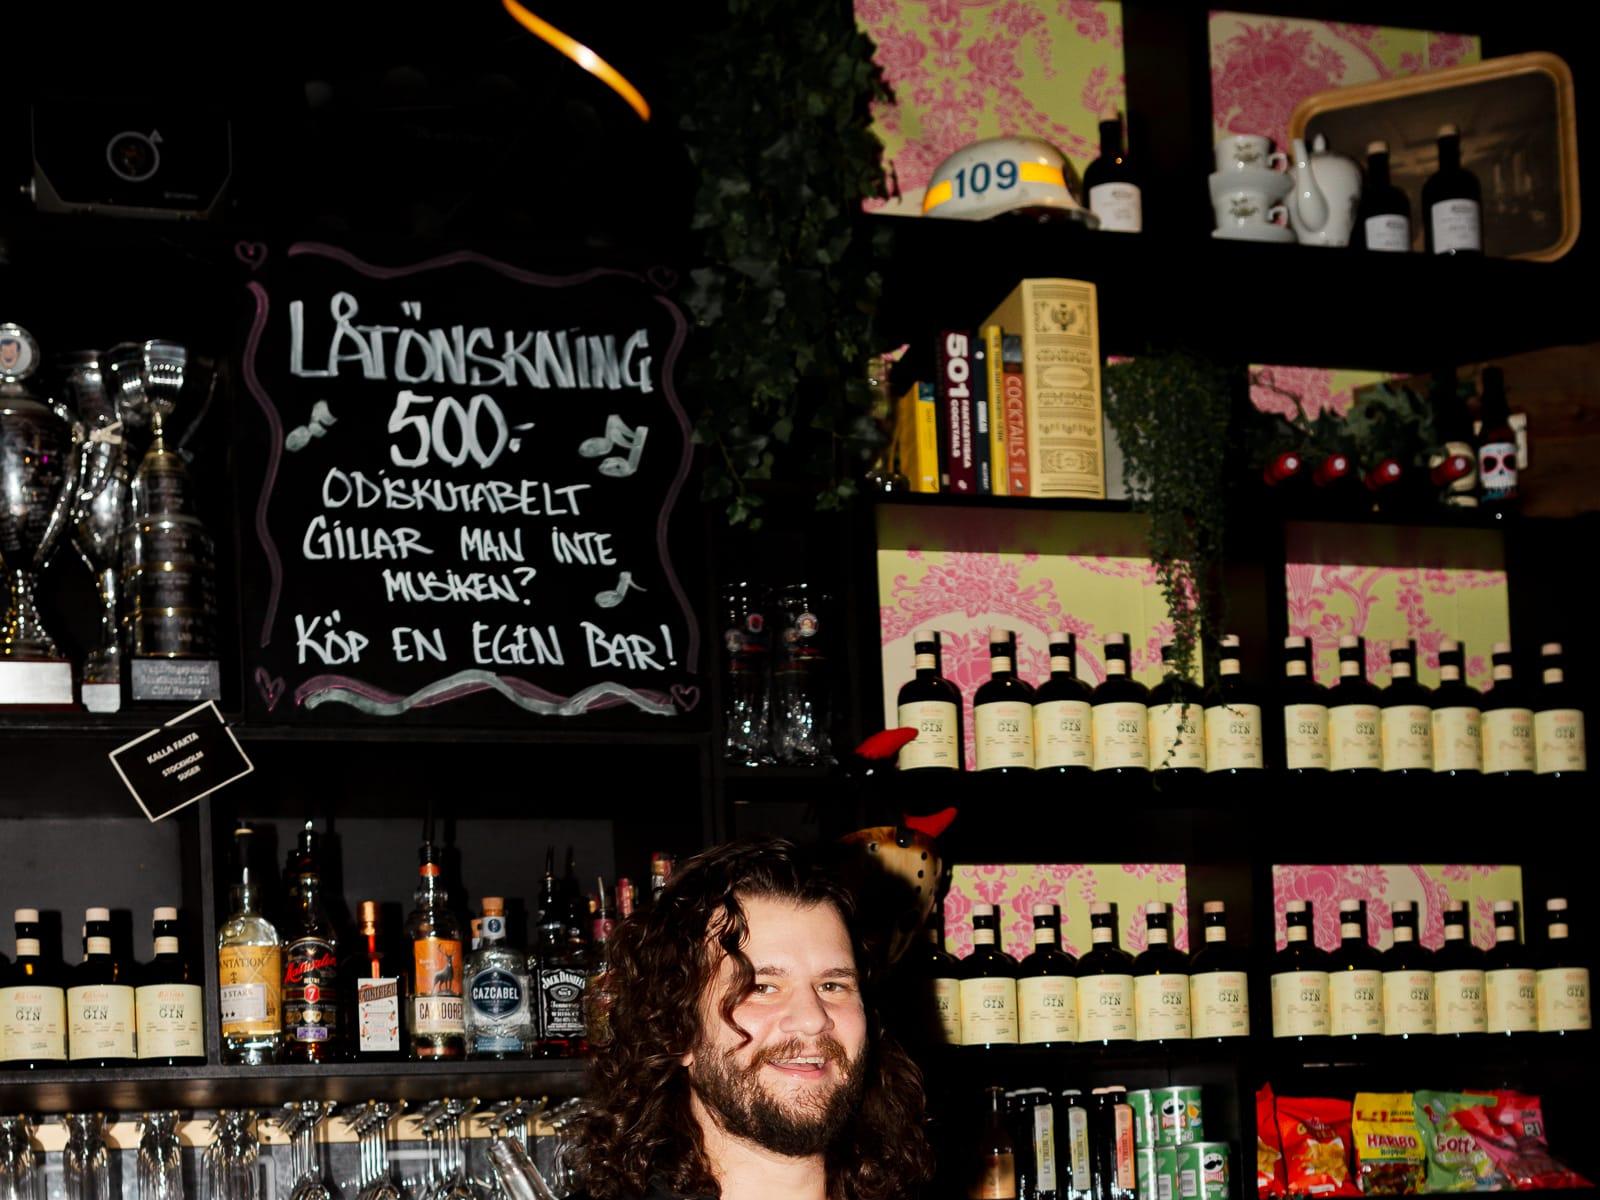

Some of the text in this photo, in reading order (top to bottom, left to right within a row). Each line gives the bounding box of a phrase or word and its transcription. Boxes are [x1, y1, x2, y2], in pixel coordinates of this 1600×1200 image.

[955, 160, 1019, 199] 109
[289, 291, 653, 393] LÅTÖNSKNING
[946, 333, 970, 398] 501
[1005, 375, 1026, 458] COCKTAILS
[950, 400, 961, 458] COCKTAILS
[961, 400, 972, 469] FANTASTISKA
[322, 467, 591, 515] ODISKUTABELT
[303, 515, 617, 565] GILLAR MAN INTE
[382, 567, 537, 605] MUSIKEN?
[295, 609, 678, 671] KÖP EN EGEN BAR!
[920, 722, 943, 733] GIN
[1060, 720, 1081, 732] GIN
[1117, 721, 1139, 733] GIN
[147, 732, 199, 764] KALLA FAKTA
[162, 750, 204, 777] STOCKHOLM
[541, 974, 560, 989] JACK
[309, 988, 315, 1000] 7
[472, 987, 519, 1001] CAZCABEL
[1161, 995, 1182, 1005] GIN
[1218, 993, 1239, 1002] GIN
[1300, 991, 1321, 1001] GIN
[1354, 991, 1375, 1001] GIN
[1410, 991, 1430, 1001] GIN
[1461, 990, 1481, 1000] GIN
[983, 1000, 1004, 1009] GIN
[1042, 998, 1064, 1008] GIN
[1100, 996, 1121, 1006] GIN
[15, 1010, 40, 1021] GIN
[83, 1009, 108, 1020] GIN
[159, 1008, 184, 1019] GIN
[1367, 1134, 1416, 1149] HARIBO
